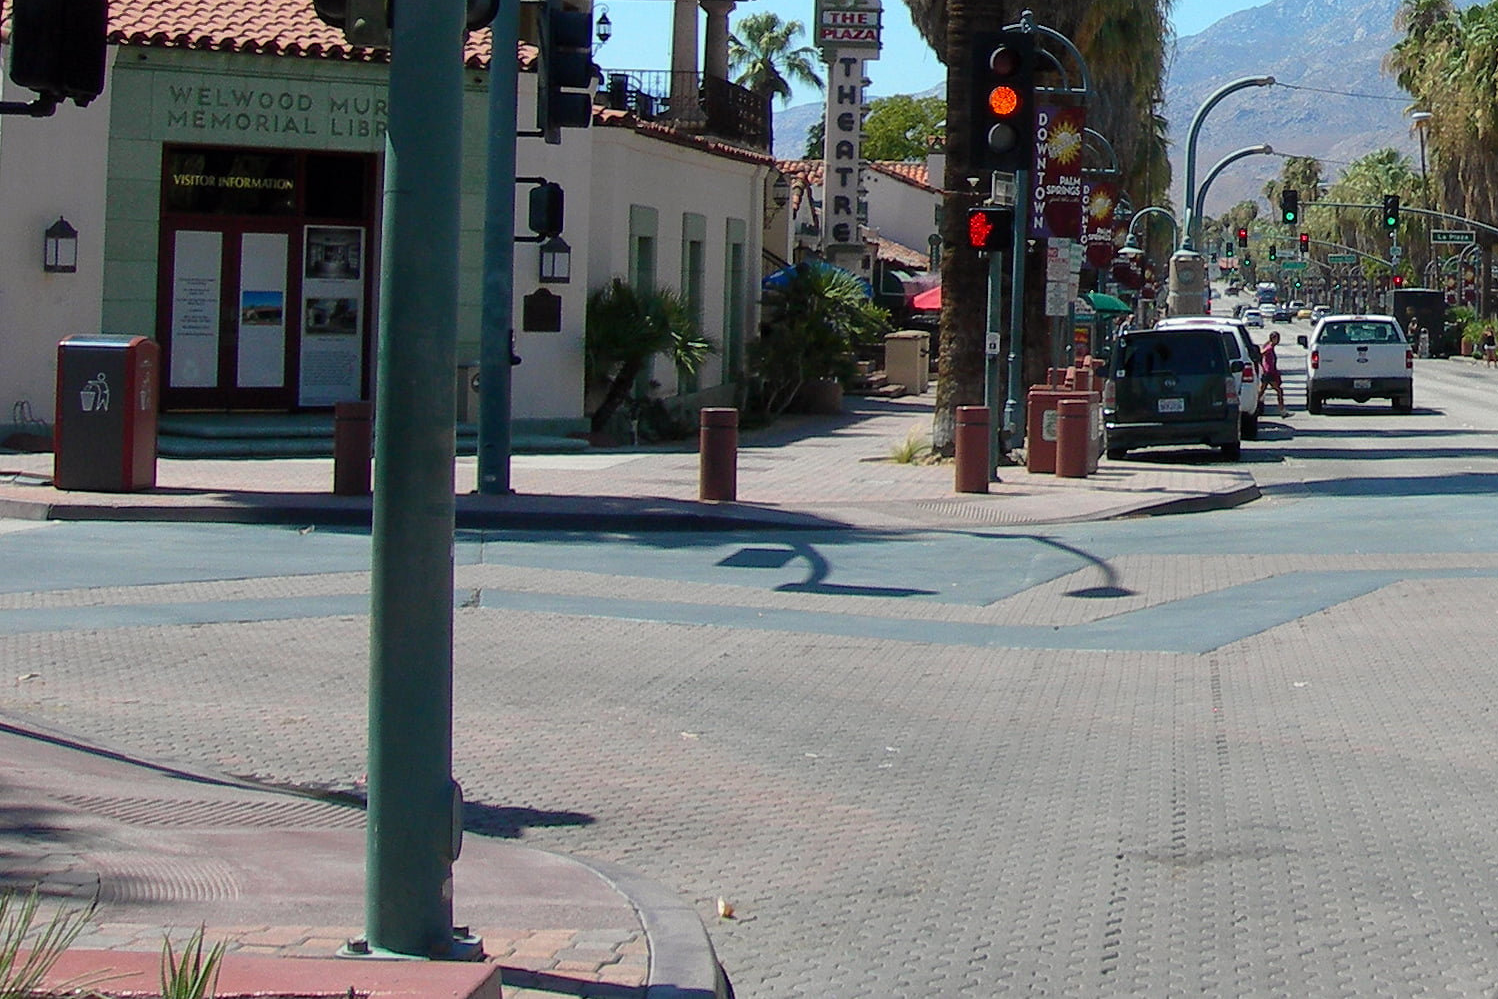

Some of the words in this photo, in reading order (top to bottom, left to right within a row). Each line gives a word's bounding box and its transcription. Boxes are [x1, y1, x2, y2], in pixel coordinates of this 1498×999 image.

[830, 12, 868, 25] THE
[821, 28, 876, 41] PLAZA
[169, 84, 314, 112] WELWOOD
[167, 109, 317, 135] MEMORIAL
[832, 57, 857, 244] THEATRE
[1033, 112, 1048, 230] DOWNTOWN
[173, 174, 216, 187] VISITOR
[218, 176, 294, 190] INFORMATION
[1060, 175, 1081, 186] PALM
[1046, 184, 1081, 197] SPRINGS
